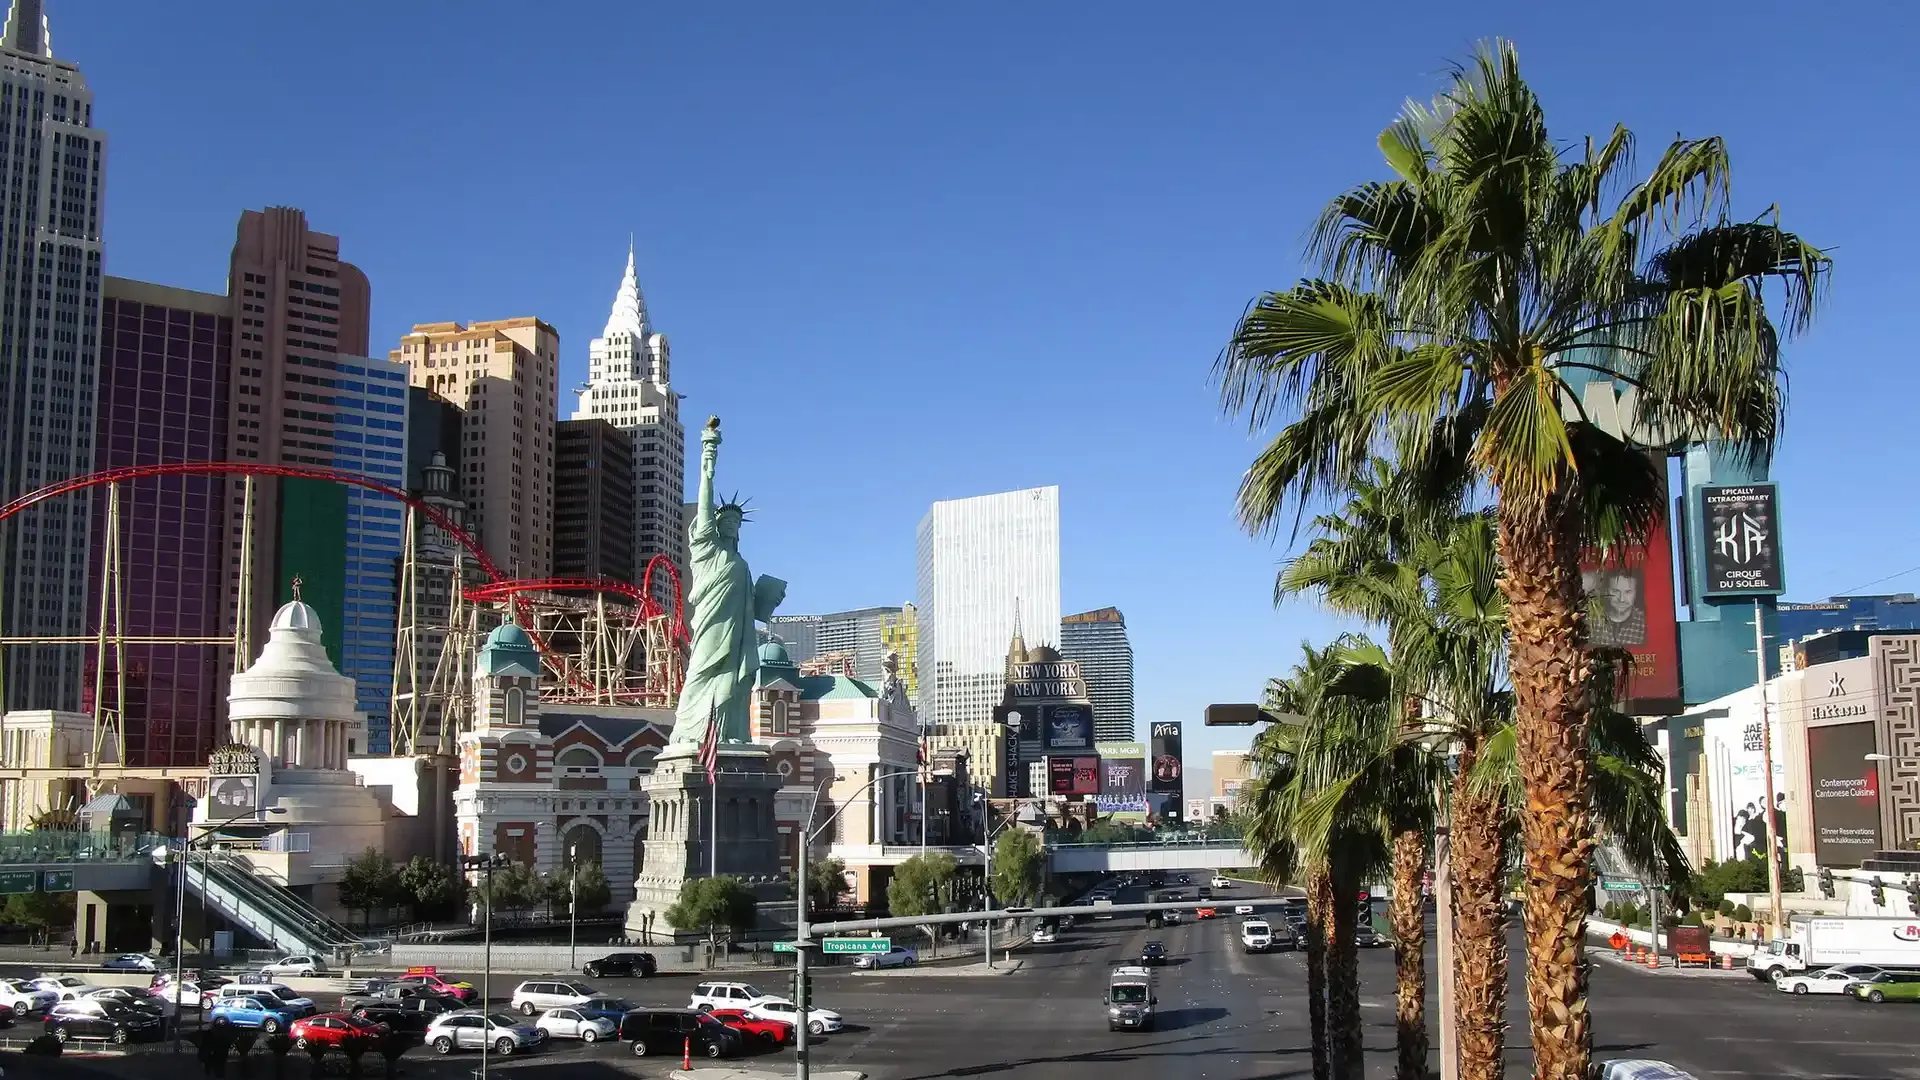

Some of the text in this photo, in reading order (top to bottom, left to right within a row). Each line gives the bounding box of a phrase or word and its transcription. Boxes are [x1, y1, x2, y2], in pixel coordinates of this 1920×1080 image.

[1707, 494, 1769, 503] EXTRAORDINARY
[1725, 570, 1762, 580] CIRQUE
[1720, 579, 1769, 589] DU SOLEIL
[779, 615, 823, 623] COSMOPOLITAN
[1014, 664, 1077, 679] NEW YORK
[1014, 682, 1078, 697] NEW YORK
[1811, 704, 1867, 720] Hakkasan
[1154, 723, 1179, 737] Aria
[1008, 730, 1018, 767] SHACK
[1099, 747, 1140, 756] PARK MGM
[208, 753, 257, 764] NEW YORK
[208, 763, 257, 774] NEW YORK
[1108, 775, 1128, 787] HIT
[1820, 778, 1868, 788] Contemporary
[1815, 788, 1875, 798] Cantonese Cuisine
[1821, 827, 1875, 835] Dinner Reservations
[1822, 837, 1875, 845] www.hakkasan.com
[826, 942, 887, 951] Tropicana Ave
